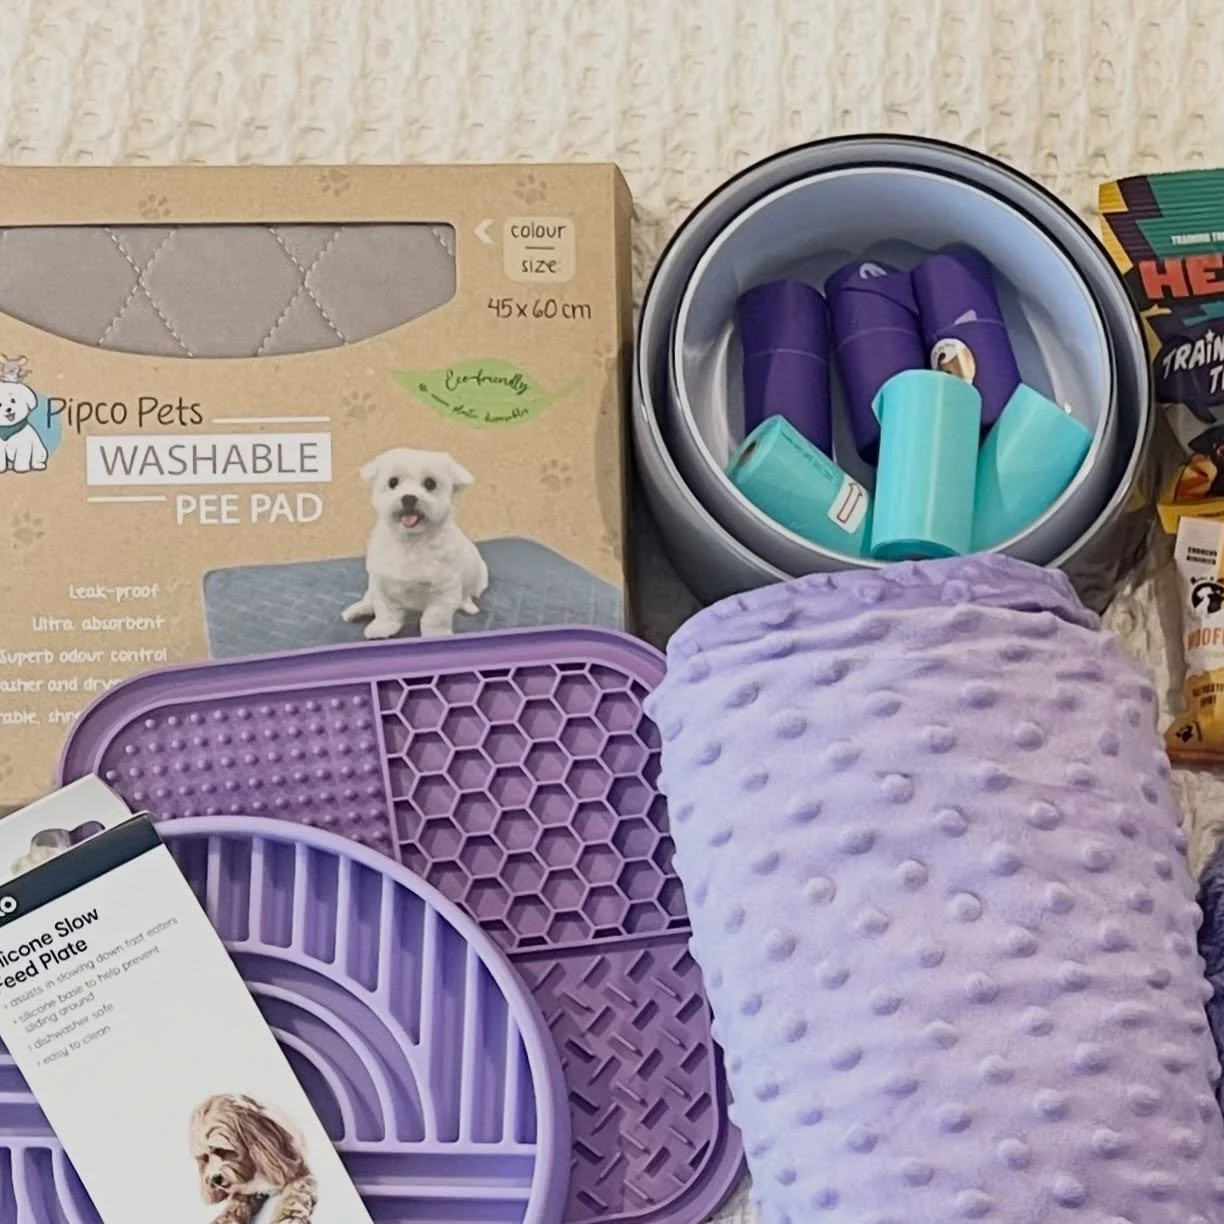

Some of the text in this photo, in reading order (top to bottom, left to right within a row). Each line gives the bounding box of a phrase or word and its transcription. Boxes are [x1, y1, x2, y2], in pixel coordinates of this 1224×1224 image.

[510, 222, 567, 241] colour
[521, 258, 558, 274] size
[46, 396, 204, 433] Pipco Pets
[100, 443, 320, 477] WASHABLE
[177, 493, 322, 525] PEE PAD
[69, 584, 161, 602] Leak-proof
[82, 615, 166, 632] absorbent
[59, 648, 104, 663] odour
[110, 647, 168, 663] control
[48, 678, 79, 693] and
[54, 907, 99, 939] Slow
[39, 938, 89, 971] Plate
